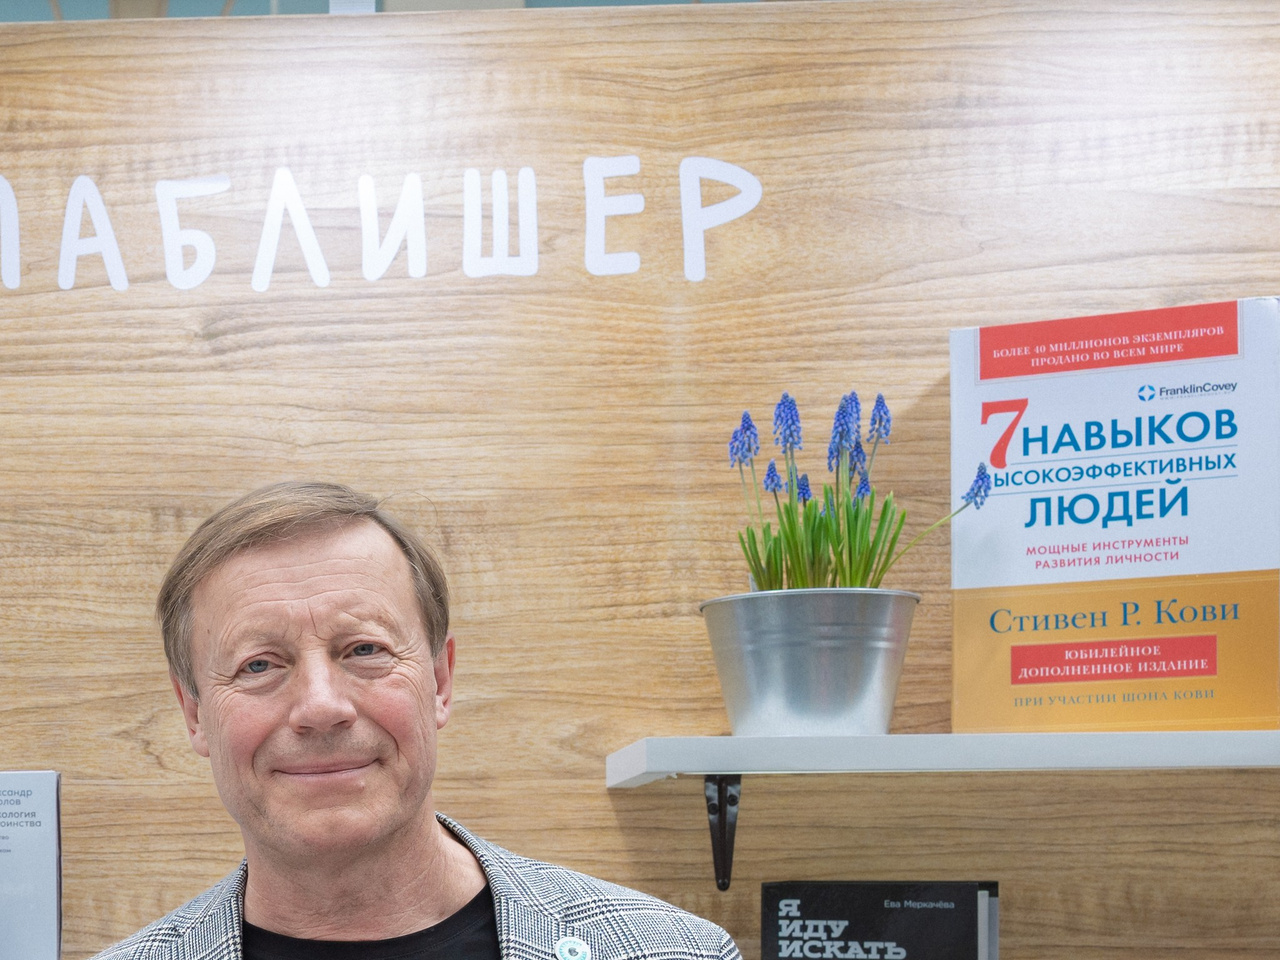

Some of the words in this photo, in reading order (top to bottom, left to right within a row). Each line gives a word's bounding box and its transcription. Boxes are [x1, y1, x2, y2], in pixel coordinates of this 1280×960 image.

[993, 346, 1031, 358] БОЛЕЕ
[1033, 344, 1047, 354] 40
[1049, 336, 1130, 352] МИЛЛИОНОВ
[1132, 326, 1224, 344] ЭКЗЕМПЛЯРОВ
[1031, 352, 1090, 367] ПРОДАНО
[1093, 351, 1110, 361] ВО
[1113, 347, 1146, 359] ВСЕМ
[1149, 343, 1184, 355] МИРЕ
[1159, 382, 1238, 397] FranklinCovey
[981, 398, 1028, 468] 7
[1022, 408, 1238, 457] НАВЫКОВ
[993, 453, 1237, 487] ЫСОКОЭФФЕКТИВНЫХ
[1025, 478, 1188, 529] ЛЮДЕЙ
[1026, 543, 1087, 556] МОЩНЫЕ
[1092, 536, 1189, 551] ИНСТРУМЕНТЫ
[1035, 557, 1101, 569] РАЗВИТИЯ
[1105, 551, 1179, 565] ЛИЧНОСТИ
[989, 608, 1108, 634] Стивен
[1120, 601, 1141, 626] Р.
[1154, 598, 1240, 624] Кови
[1064, 645, 1161, 660] ЮБИЛЕЙНОЕ
[1018, 663, 1133, 679] ДОПОЛНЕННОЕ
[1138, 659, 1209, 673] ИЗДАНИЕ
[1014, 697, 1044, 707] ПРИ
[1048, 693, 1117, 706] УЧАСТИИ
[1122, 692, 1168, 702] ШОНА
[1173, 689, 1215, 700] КОВИ
[778, 899, 801, 917] Я
[884, 900, 901, 908] Ева
[904, 900, 955, 909] Меркачёва
[778, 919, 849, 940] ИДУ
[778, 940, 907, 960] ИСКАТЬ
